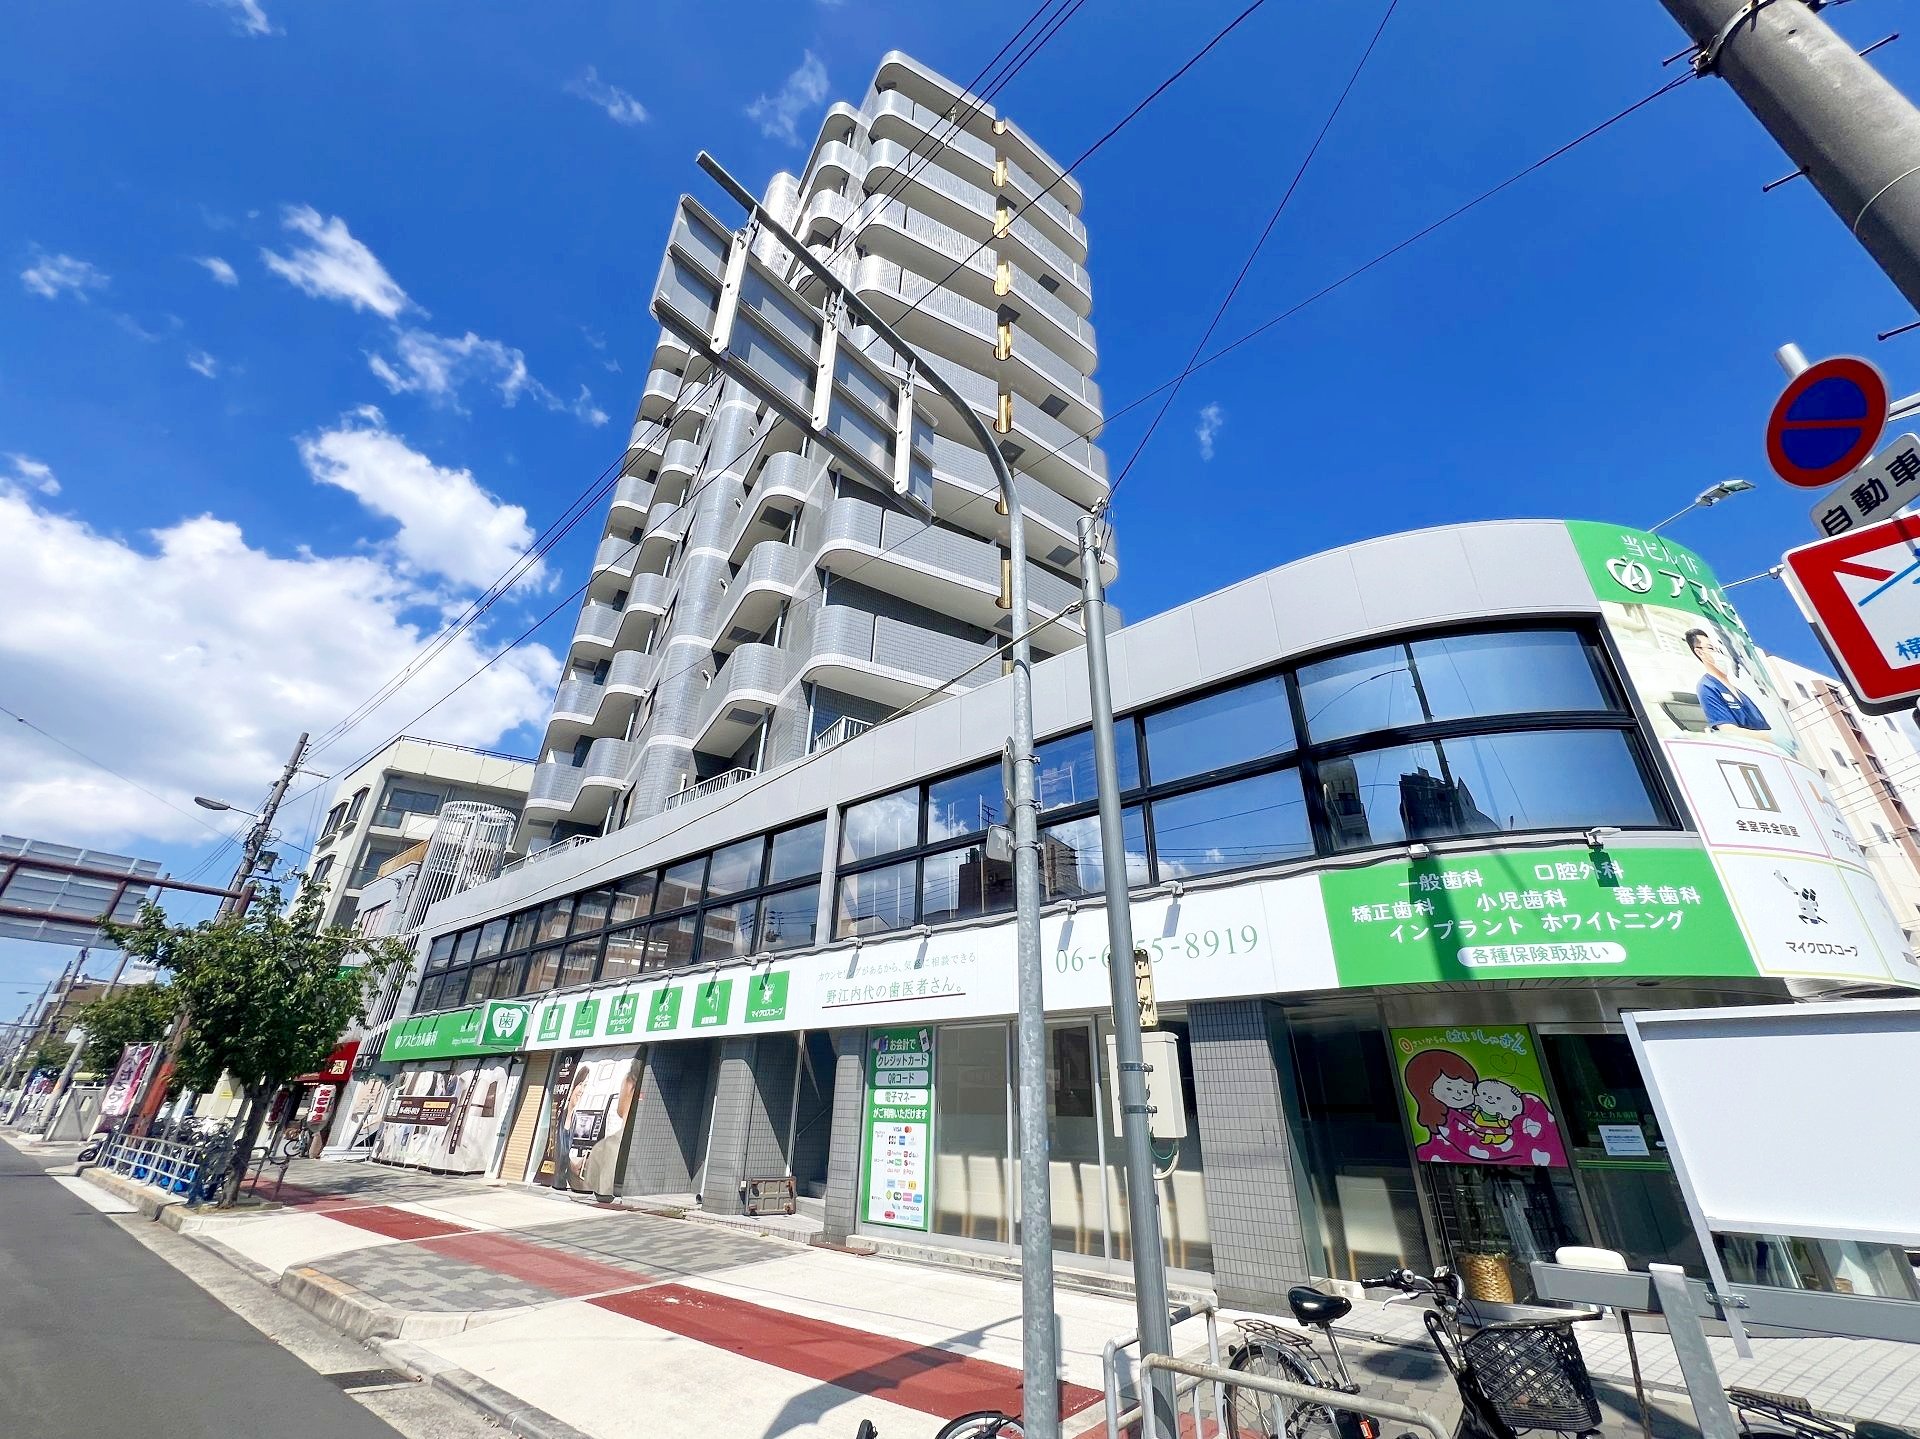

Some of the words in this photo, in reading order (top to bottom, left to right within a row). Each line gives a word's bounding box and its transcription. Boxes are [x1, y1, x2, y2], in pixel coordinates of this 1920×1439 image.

[1821, 447, 1920, 536] 自動車
[1735, 819, 1801, 838] 全室完全個室
[1398, 869, 1484, 891] 一般歯科
[1534, 860, 1625, 881] 口腔外科
[1351, 898, 1435, 923] 矯正歯科
[1477, 888, 1568, 912] 小児歯科
[1613, 885, 1701, 906] 審美歯科
[1390, 916, 1524, 943] インプラント
[1541, 909, 1684, 933] ホワイトニング
[1472, 945, 1609, 965] 各種保険取扱い
[1785, 941, 1859, 957] マイクロスコープ
[826, 976, 962, 1004] 野江内代の歯医者さん。
[499, 1012, 517, 1028] 歯
[751, 1007, 784, 1018] マイクロスコープ
[889, 1038, 916, 1051] お会計で
[878, 1054, 927, 1067] クレジットカード
[888, 1072, 915, 1085] QRコード
[885, 1091, 917, 1103] 電子マネー
[873, 1107, 928, 1120] がご利用いただけます
